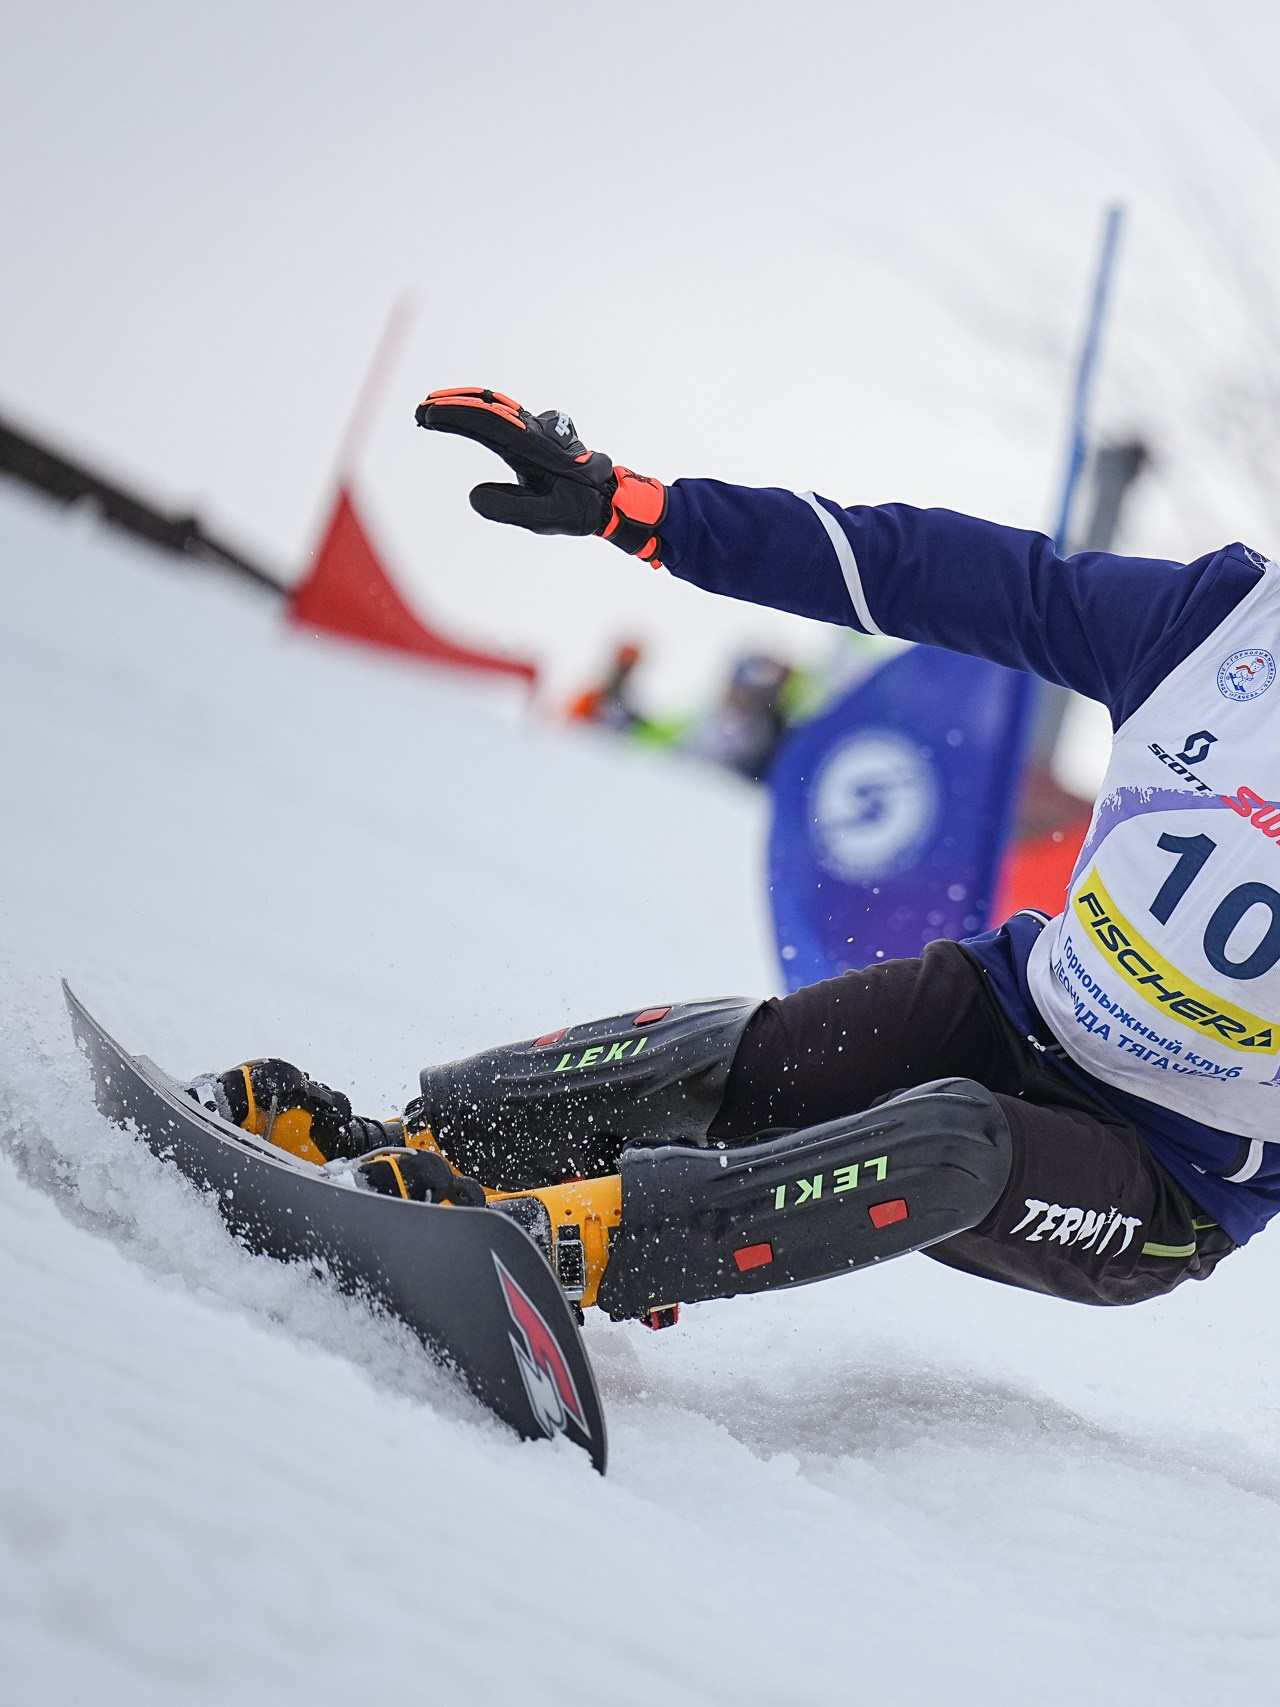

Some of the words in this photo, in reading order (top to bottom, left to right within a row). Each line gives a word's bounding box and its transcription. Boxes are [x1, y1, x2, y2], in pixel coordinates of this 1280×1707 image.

[1148, 743, 1212, 793] SCOTT
[1054, 958, 1112, 1042] ЛЕОНИДА
[1078, 892, 1247, 1040] FISCHER
[1063, 935, 1183, 1055] Горнолыжный
[1184, 1052, 1243, 1079] клуб
[553, 1037, 648, 1072] LEKI
[775, 1156, 888, 1210] LEKI
